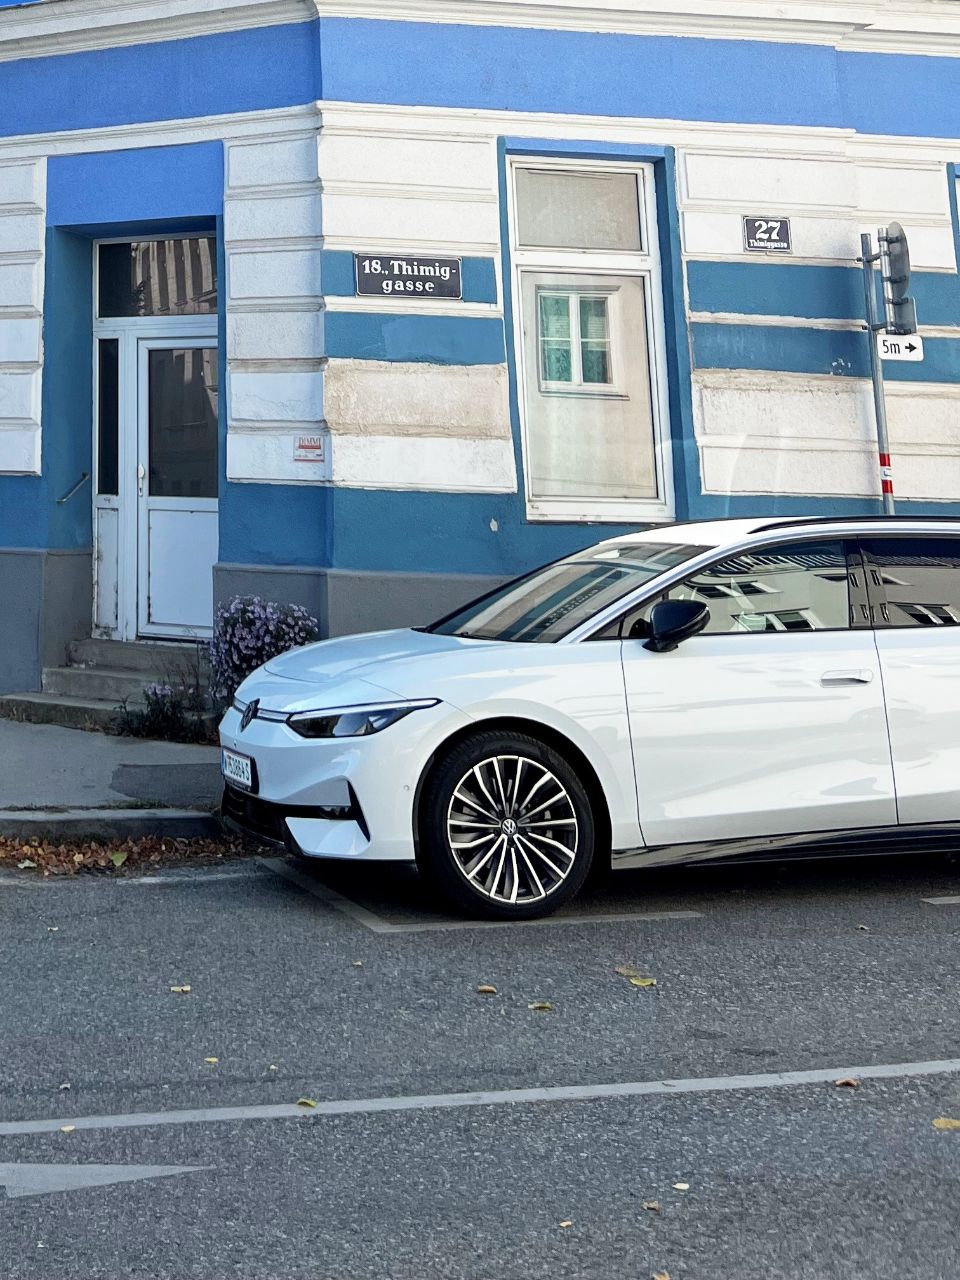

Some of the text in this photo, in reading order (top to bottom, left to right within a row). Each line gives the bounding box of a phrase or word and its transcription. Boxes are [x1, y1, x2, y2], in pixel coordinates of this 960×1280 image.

[754, 220, 781, 240] 27
[362, 259, 457, 281] 18., Thimig-
[382, 280, 435, 294] gasse
[882, 339, 901, 355] 5m
